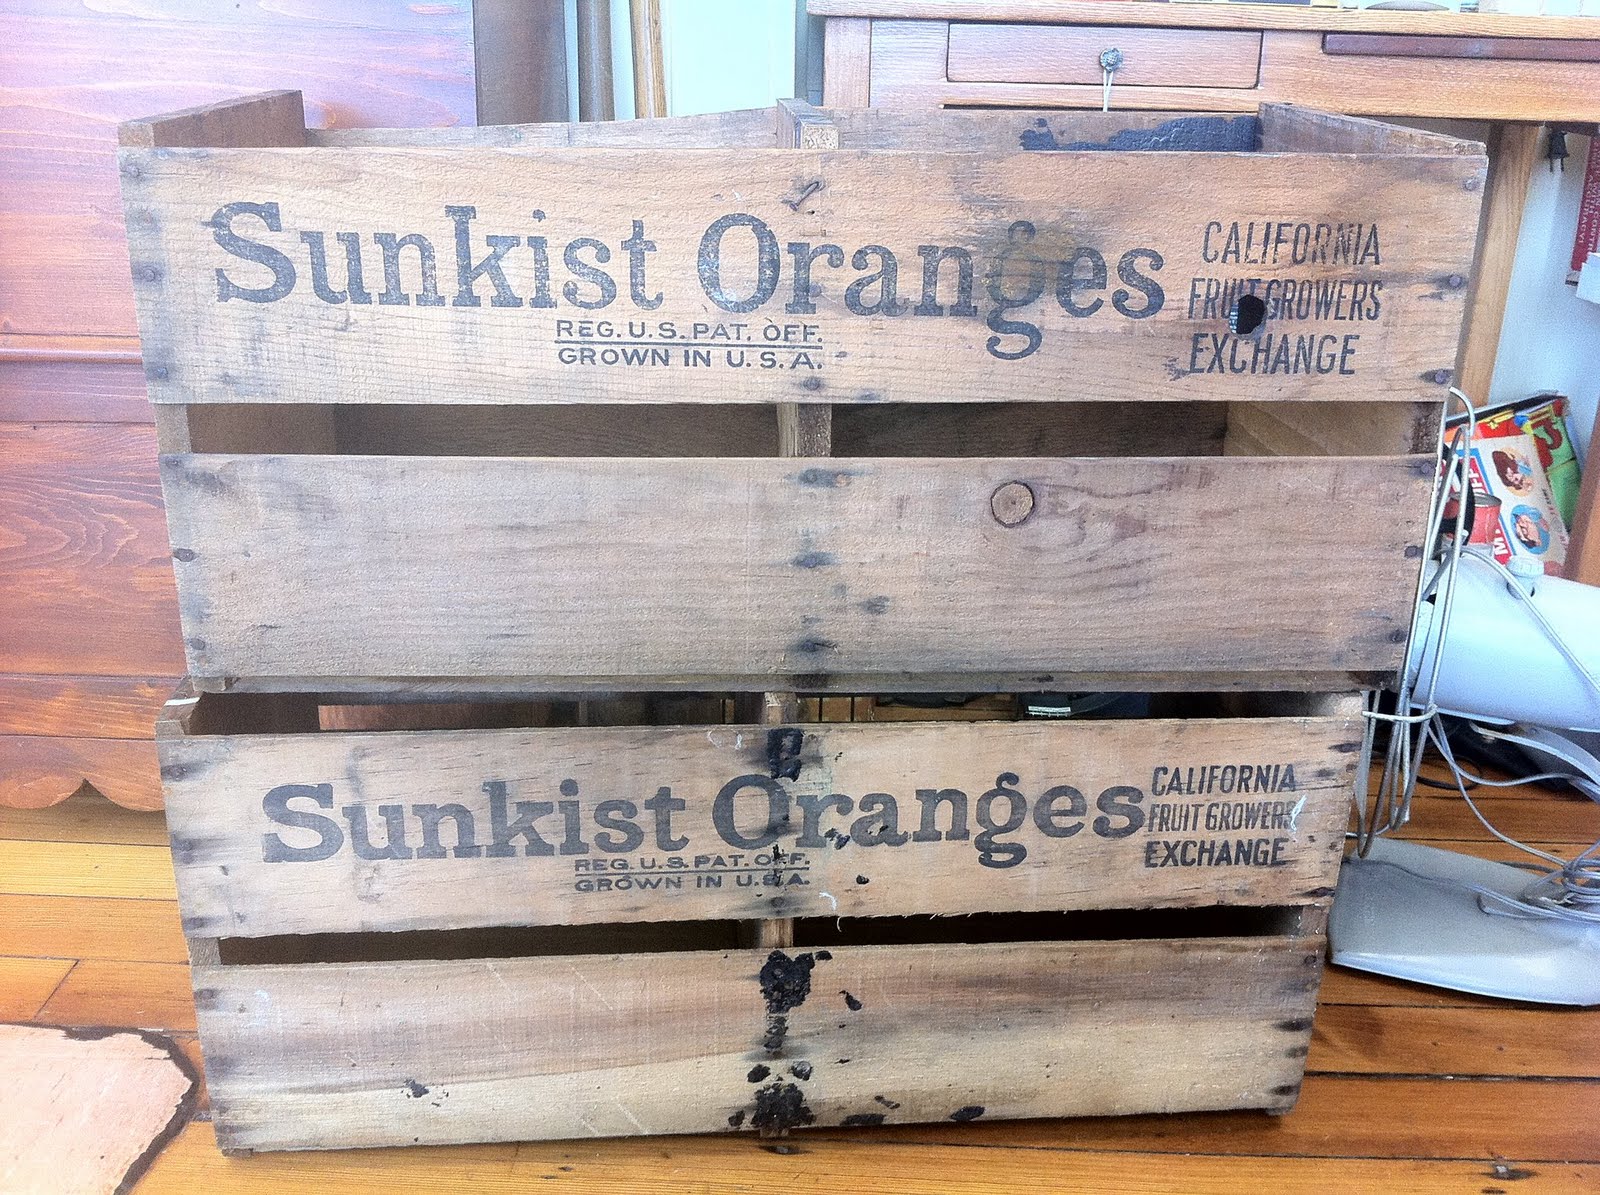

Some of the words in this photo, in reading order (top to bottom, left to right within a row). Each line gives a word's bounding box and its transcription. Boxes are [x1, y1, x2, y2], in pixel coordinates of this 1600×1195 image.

[1202, 220, 1381, 267] CALIFORNIA
[210, 201, 664, 310] Sunkist
[698, 212, 1164, 360] Oranges
[1263, 278, 1383, 321] GROWERS
[556, 319, 622, 338] REG.
[628, 321, 686, 340] U.S.
[693, 322, 751, 341] PAT.
[762, 323, 823, 343] OFF.
[558, 347, 670, 366] GROWN
[683, 350, 711, 367] IN
[1190, 332, 1360, 375] EXCHANGE
[1151, 764, 1296, 796] CALIFORNIA
[263, 779, 690, 864] Sunkist
[712, 772, 1146, 869] Oranges
[1148, 803, 1205, 833] FRUIT
[574, 858, 635, 872] REG.
[694, 854, 750, 869] PAT.
[1144, 837, 1291, 868] EXCHANGE
[574, 875, 681, 892] GROWN
[696, 875, 723, 888] IN
